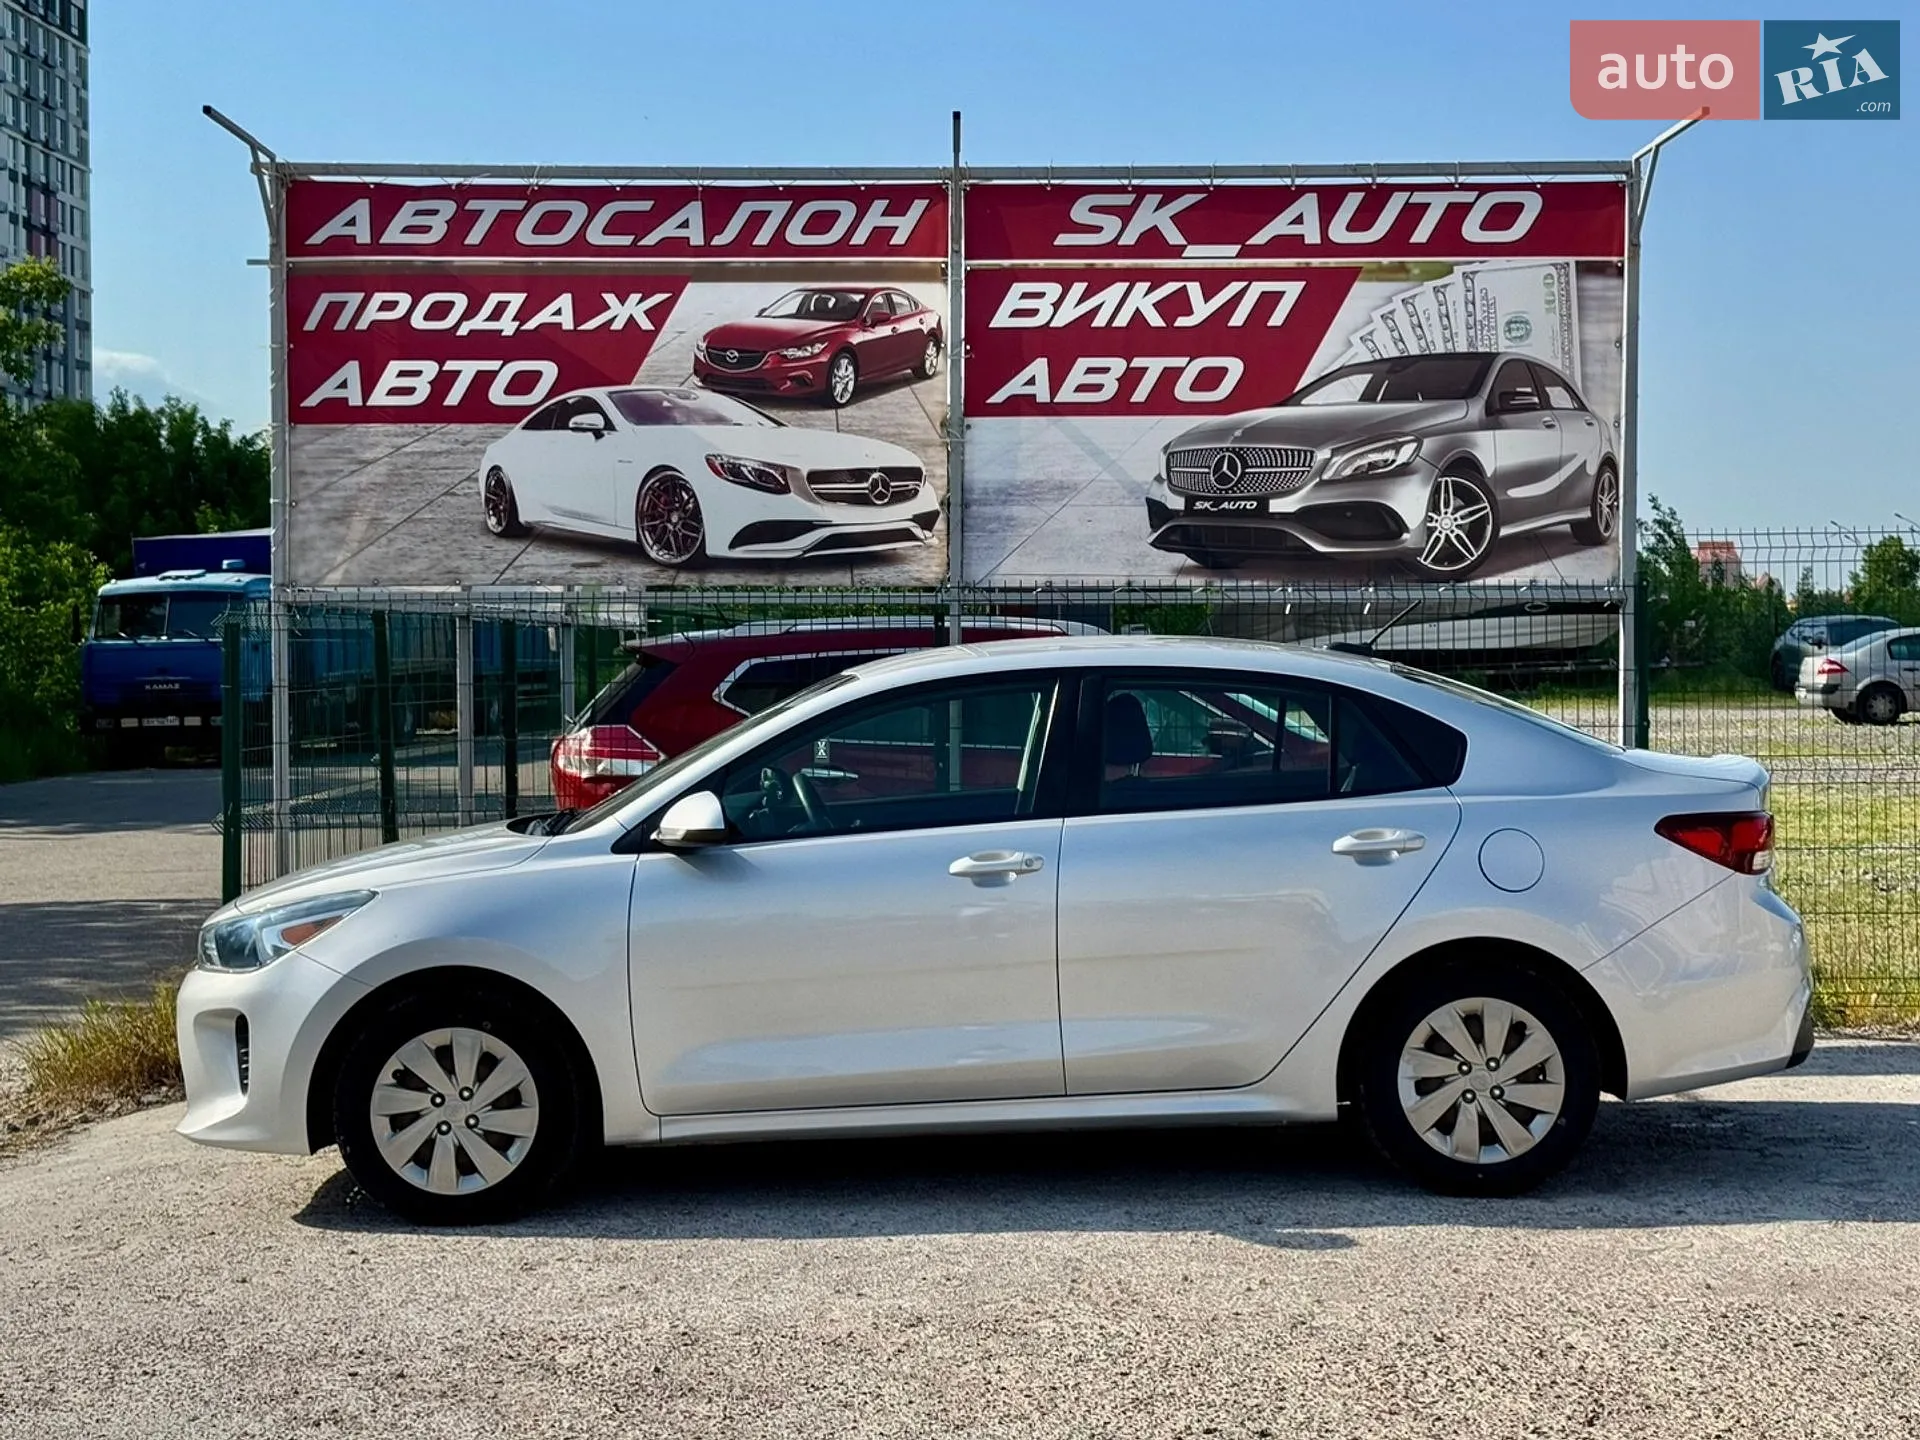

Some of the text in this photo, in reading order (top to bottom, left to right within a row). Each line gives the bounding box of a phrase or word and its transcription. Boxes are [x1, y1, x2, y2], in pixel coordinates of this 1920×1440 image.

[304, 197, 930, 247] АВТОСАЛОН
[1054, 190, 1543, 258] SK_AUTO
[302, 291, 674, 337] ПРОДАЖ
[988, 280, 1307, 329] ВИКУП
[300, 359, 560, 408] АВТО
[986, 356, 1246, 404] АВТО
[1193, 501, 1257, 511] SK_AUTO
